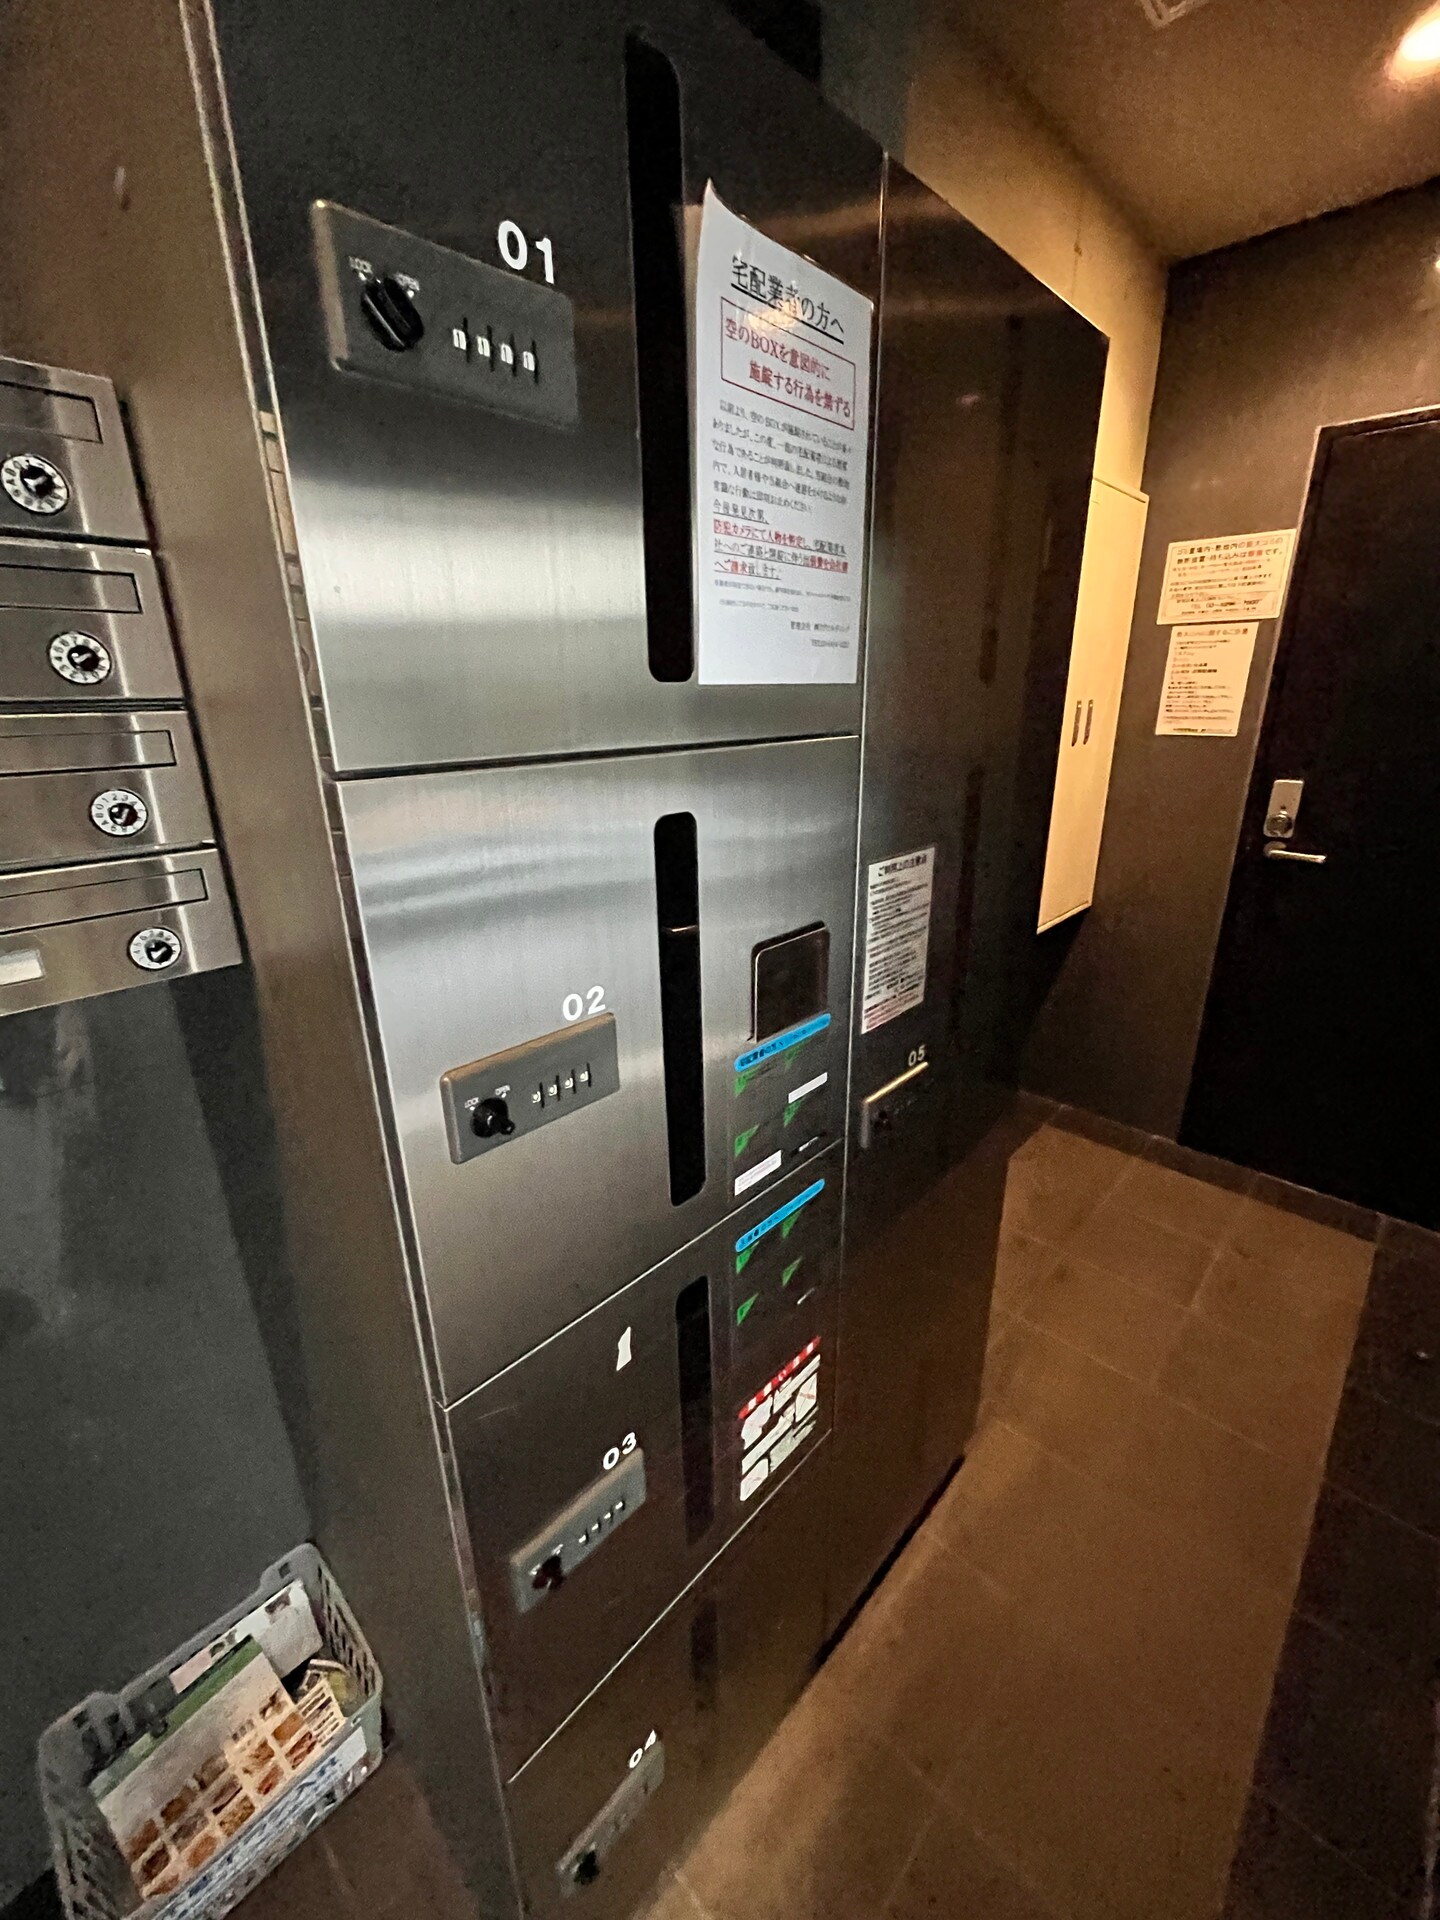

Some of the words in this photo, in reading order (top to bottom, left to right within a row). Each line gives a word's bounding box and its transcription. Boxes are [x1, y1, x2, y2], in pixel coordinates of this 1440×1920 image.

[498, 219, 555, 285] 01
[731, 254, 845, 334] 宅配業者の方へ
[724, 318, 832, 382] 空のBOXを意図的に
[748, 359, 852, 418] 施錠する行為を禁ずる
[562, 985, 606, 1022] 02
[908, 1043, 927, 1067] 05
[602, 1431, 637, 1470] 03
